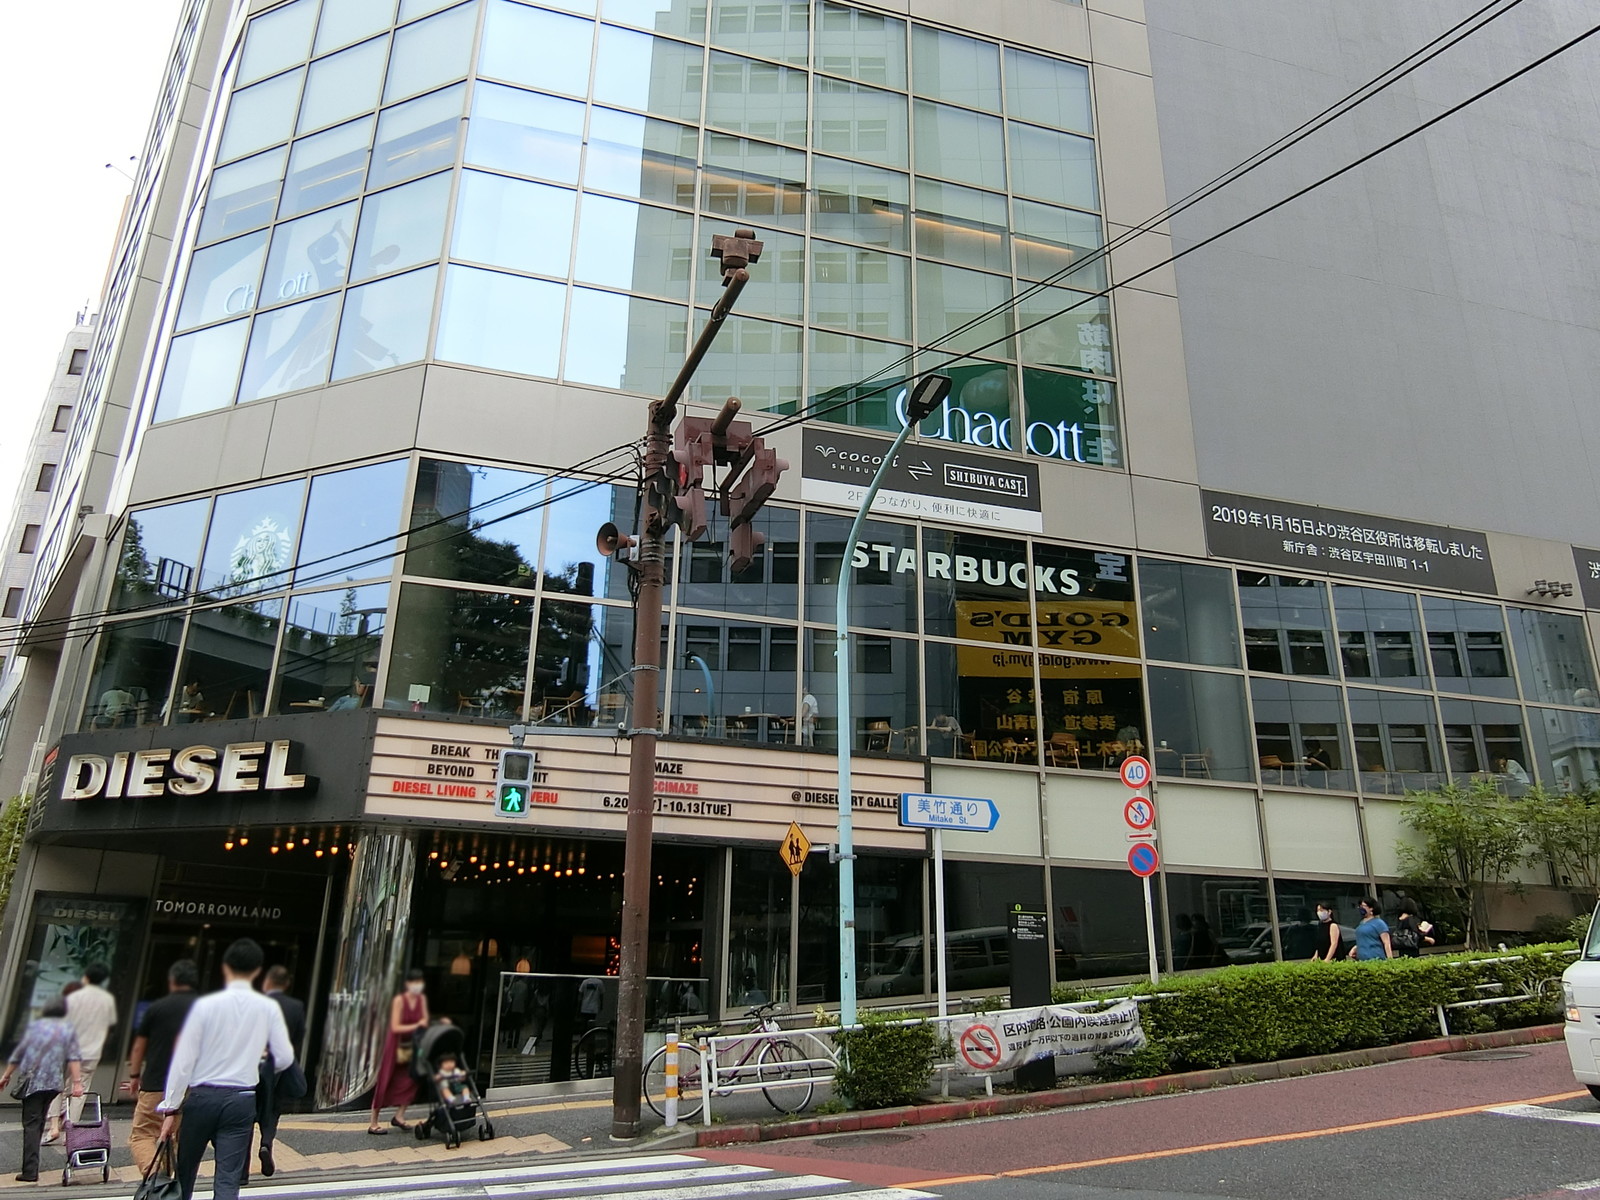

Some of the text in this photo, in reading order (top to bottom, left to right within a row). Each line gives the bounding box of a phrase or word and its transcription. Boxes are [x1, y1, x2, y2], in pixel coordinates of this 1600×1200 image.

[223, 271, 312, 316] Chott
[838, 451, 900, 468] cocoi
[831, 463, 878, 476] SHIBUY
[949, 470, 996, 487] SHIBUYA
[847, 490, 1001, 521] 2Fつながり、便利に快適に
[1212, 505, 1484, 561] 2019年1月15日より渋谷区役所は移転しました
[850, 541, 1081, 596] STARBUCKS
[431, 744, 499, 760] BREAK TH
[61, 739, 306, 800] DIESEL
[427, 763, 475, 778] BEYOND
[1127, 765, 1144, 780] 40
[392, 780, 434, 795] DIESEL
[437, 784, 476, 798] LIVING
[653, 780, 699, 795] CCIMAZE
[805, 792, 839, 805] DIESEL
[851, 796, 864, 807] RT
[867, 797, 898, 809] GALLE
[917, 798, 978, 816] 美竹通り
[928, 814, 969, 824] Mitake St.
[53, 907, 120, 921] DIESEL
[155, 899, 282, 920] TOMORROWLAND
